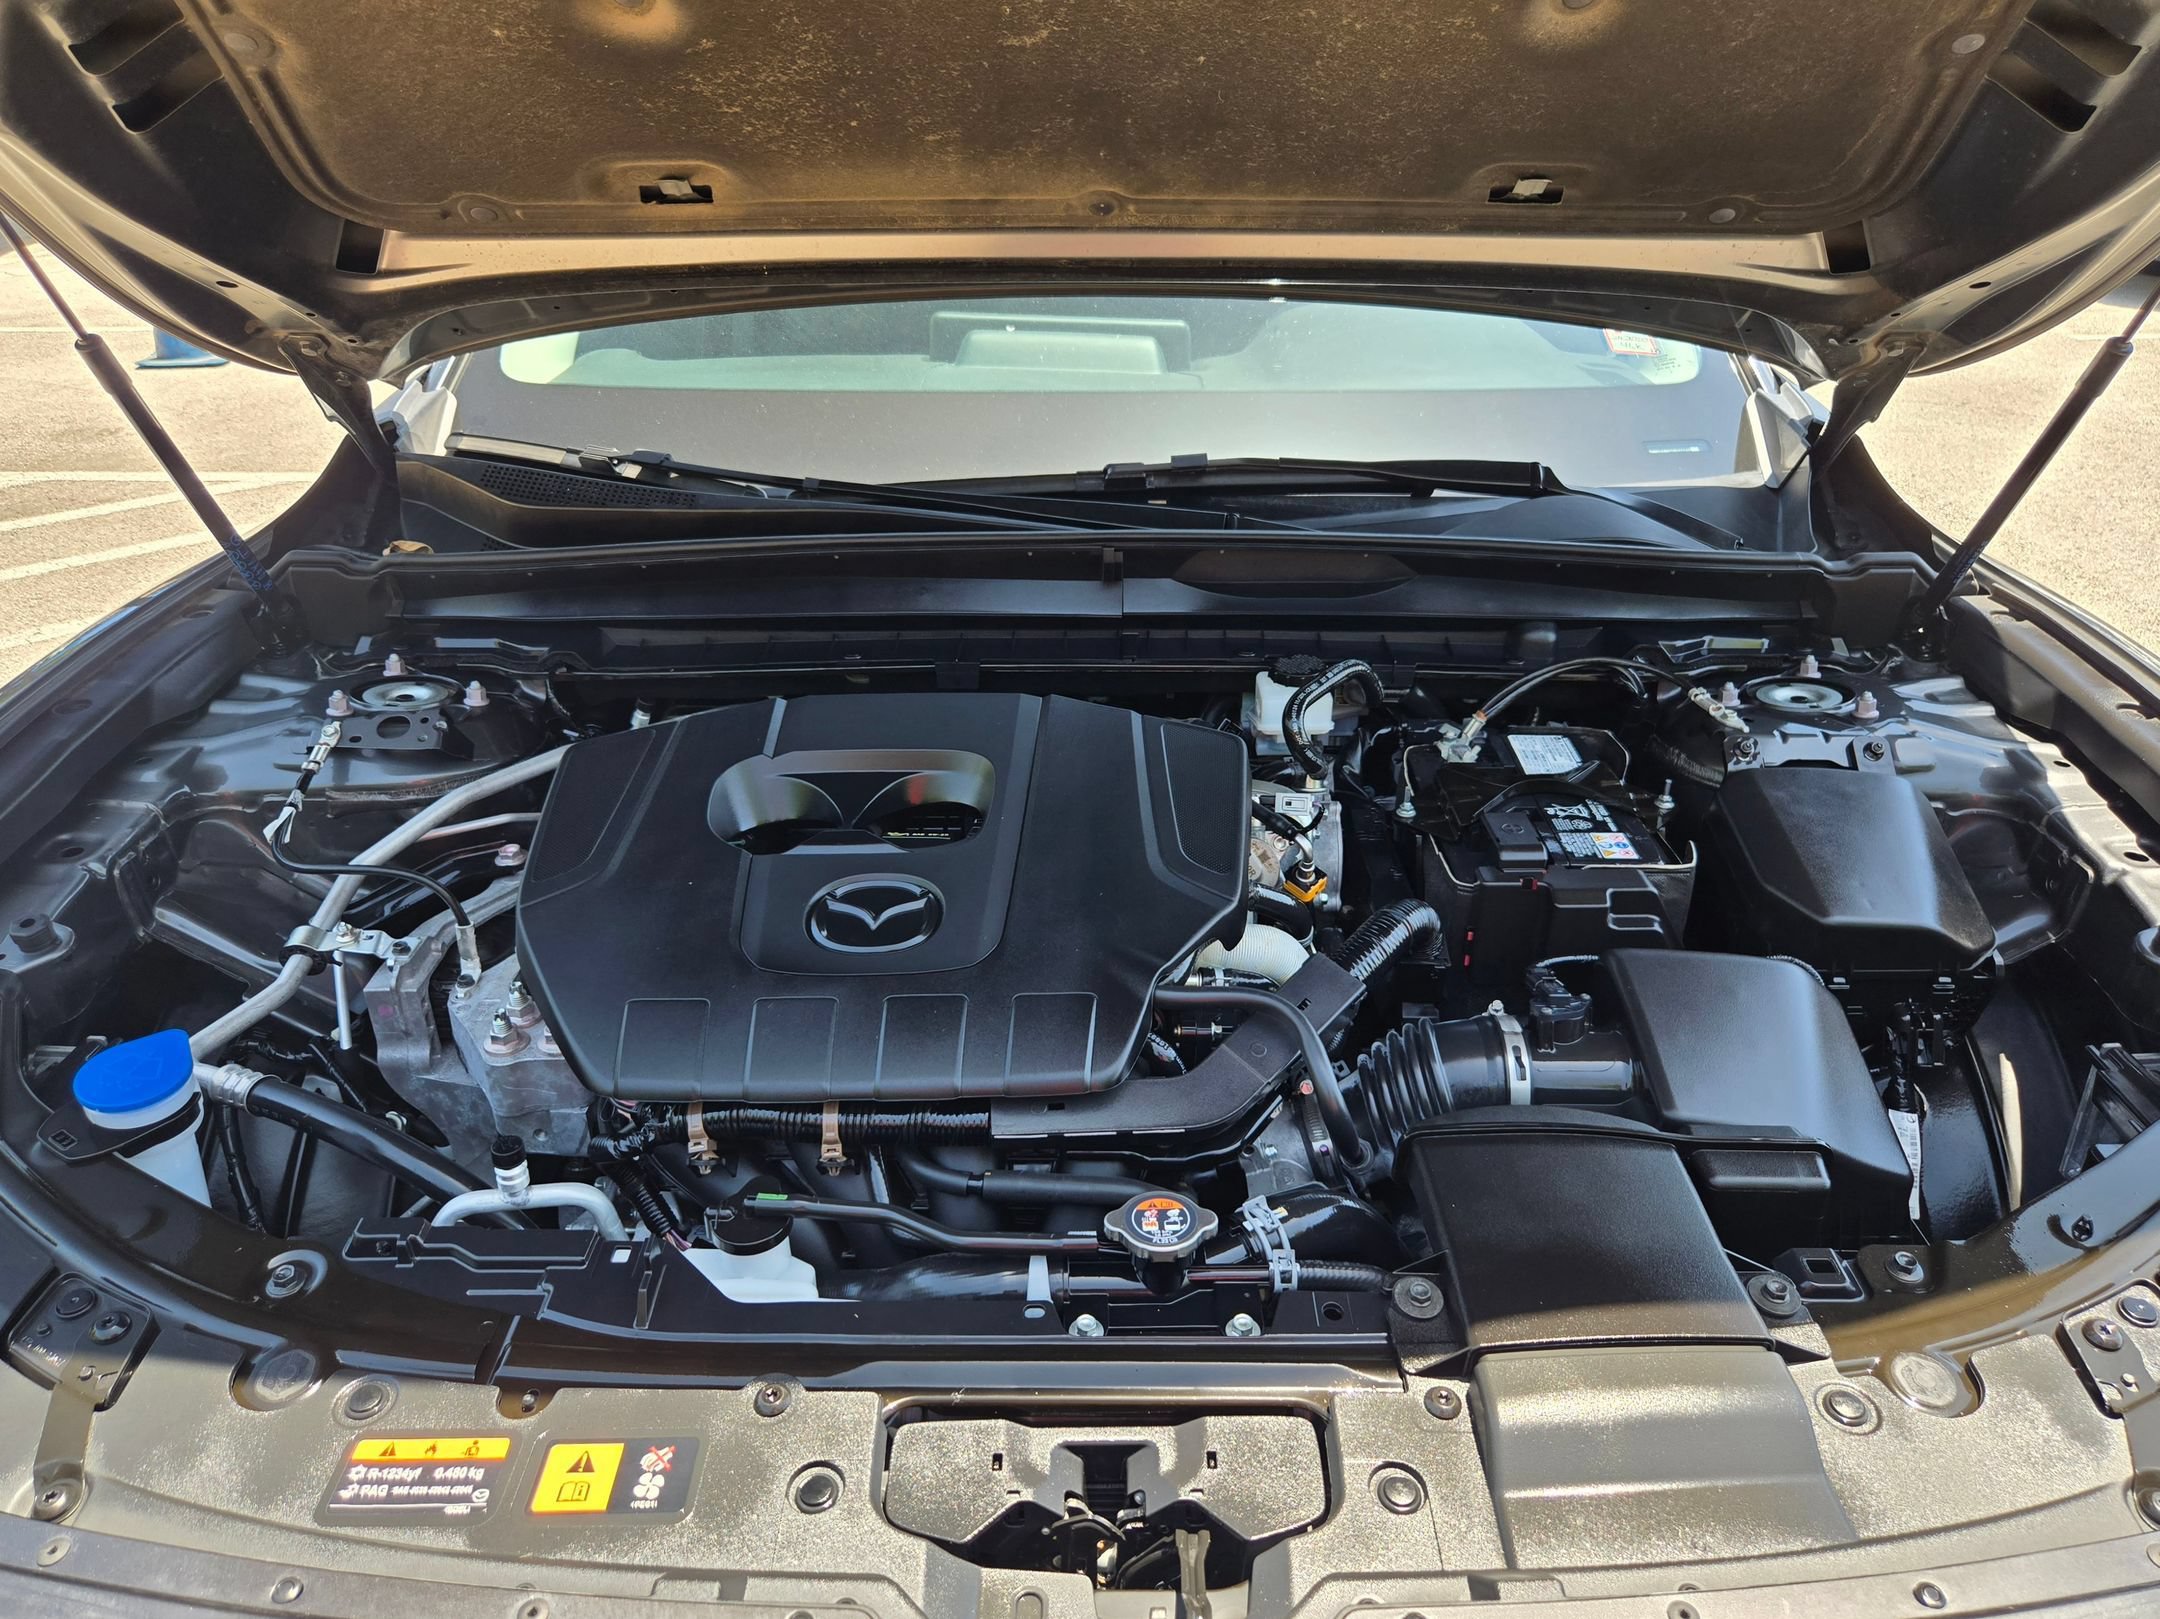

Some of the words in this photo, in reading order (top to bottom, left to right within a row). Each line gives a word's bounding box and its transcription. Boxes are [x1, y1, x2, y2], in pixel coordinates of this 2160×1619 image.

[366, 1467, 423, 1481] R-1234yf
[468, 1467, 485, 1480] kg
[359, 1484, 388, 1497] PAG
